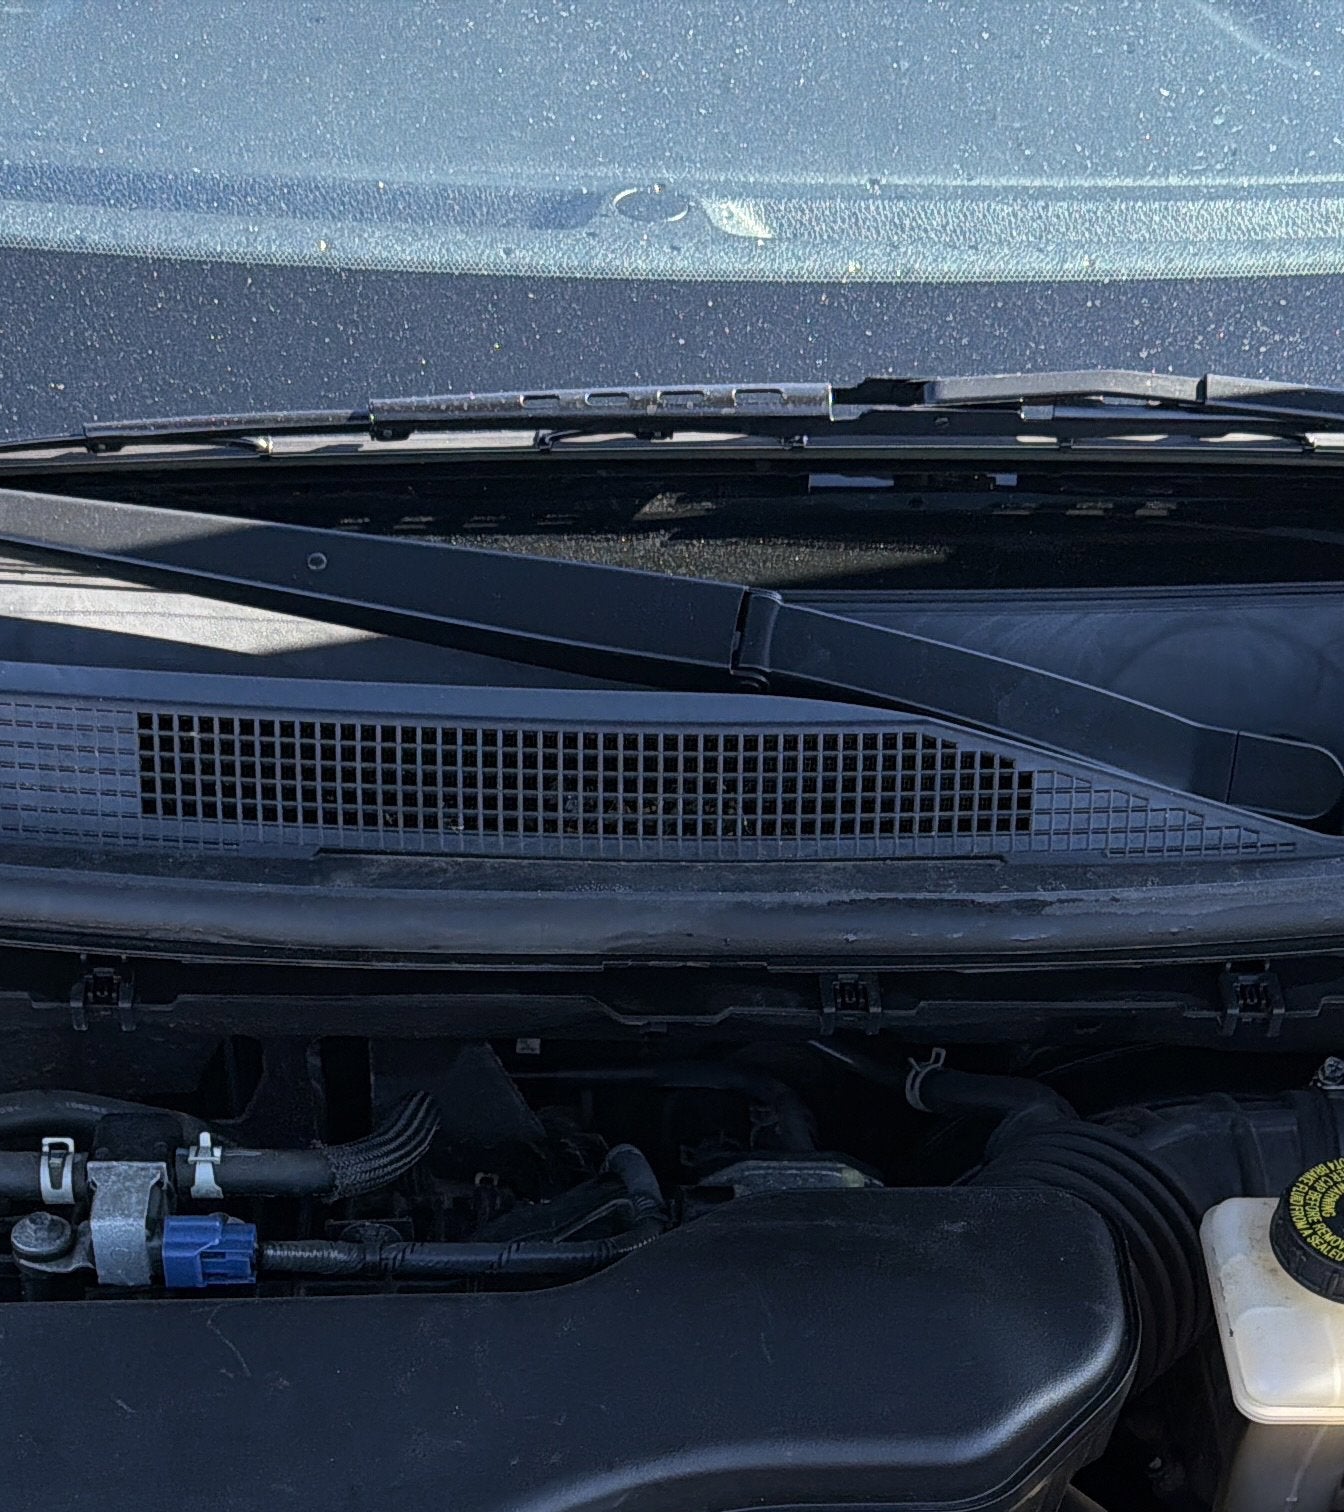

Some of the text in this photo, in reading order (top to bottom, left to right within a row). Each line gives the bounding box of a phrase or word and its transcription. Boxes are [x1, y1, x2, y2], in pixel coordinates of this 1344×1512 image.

[1299, 1163, 1329, 1187] BRAKE
[1316, 1178, 1335, 1193] CAP
[1289, 1182, 1308, 1204] FLUID
[1289, 1204, 1308, 1231] FROM
[1305, 1190, 1323, 1224] BEFORE
[1307, 1234, 1344, 1262] SEALED
